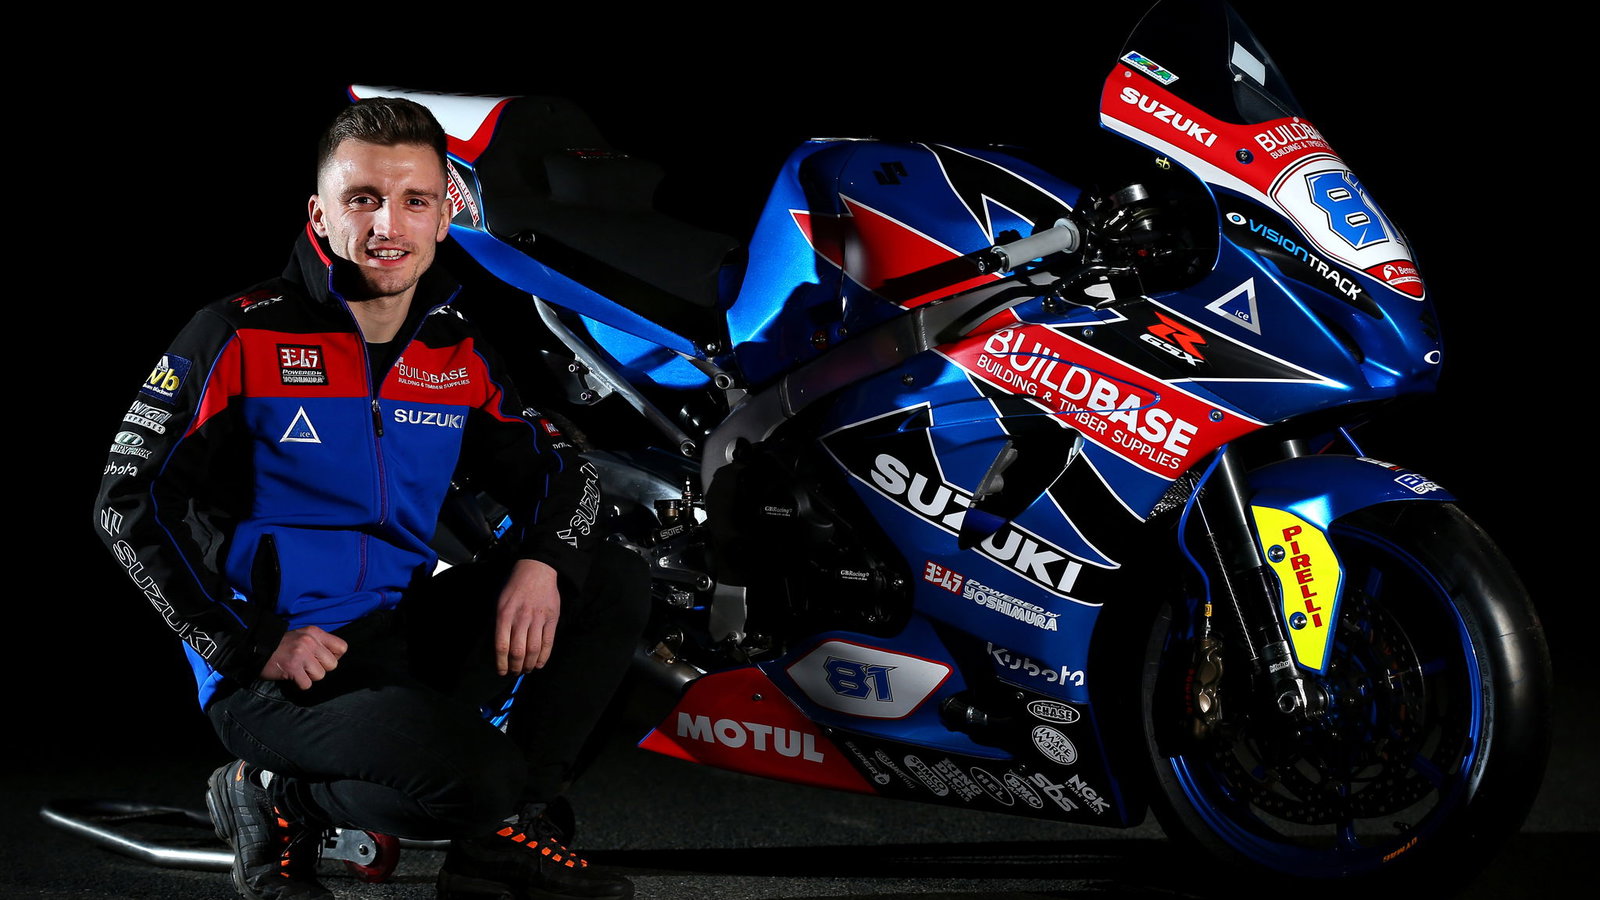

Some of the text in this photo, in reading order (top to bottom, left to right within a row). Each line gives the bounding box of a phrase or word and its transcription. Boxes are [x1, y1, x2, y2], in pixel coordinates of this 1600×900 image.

[1119, 87, 1218, 148] SUZUKI
[281, 349, 318, 368] ヨシムラ
[398, 364, 469, 384] BUILDBASE
[398, 377, 420, 387] BUILDING
[444, 379, 471, 389] SUPPLIES
[984, 327, 1199, 457] BUILDBASE
[394, 408, 465, 429] SUZUKI
[976, 355, 1182, 471] BUILDING & TIMBER SUPPLIES
[924, 562, 963, 593] ヨシムラ
[1282, 525, 1322, 628] PIRELLI
[112, 540, 217, 659] SUZUKI
[962, 585, 1058, 632] YOSHIMURA
[966, 579, 1045, 613] POWERED
[823, 656, 898, 702] 81
[986, 642, 1085, 686] Kubota
[1033, 704, 1073, 722] CHASE
[676, 711, 825, 763] MOTUL
[1034, 731, 1069, 762] WORKS
[1040, 729, 1071, 757] IMAGE
[910, 757, 946, 790] SAMCO
[935, 761, 976, 800] DICK
[942, 757, 983, 795] KING
[1007, 776, 1042, 807] BMC
[1028, 773, 1079, 812] sbs
[1068, 774, 1111, 813] NGK
